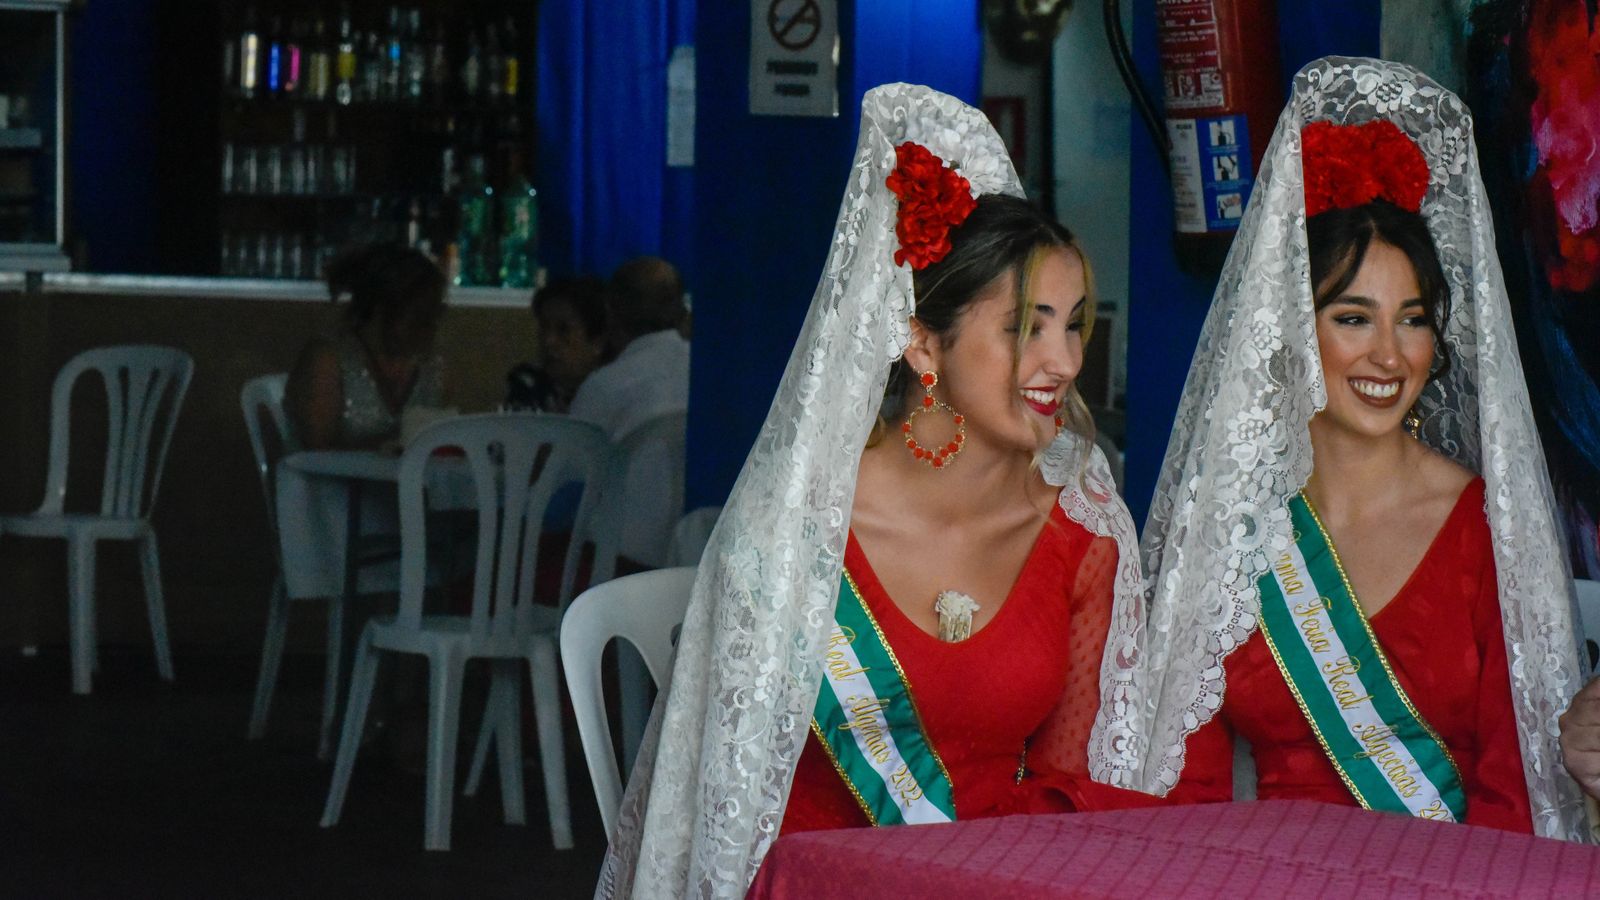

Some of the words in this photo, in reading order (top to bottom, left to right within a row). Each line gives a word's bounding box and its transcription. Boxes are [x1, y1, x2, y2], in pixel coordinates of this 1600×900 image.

[824, 625, 871, 682] Real
[889, 763, 924, 808] 2022
[1292, 595, 1333, 654] Feria
[1321, 655, 1375, 711] Real
[1352, 723, 1423, 799] Algeciras
